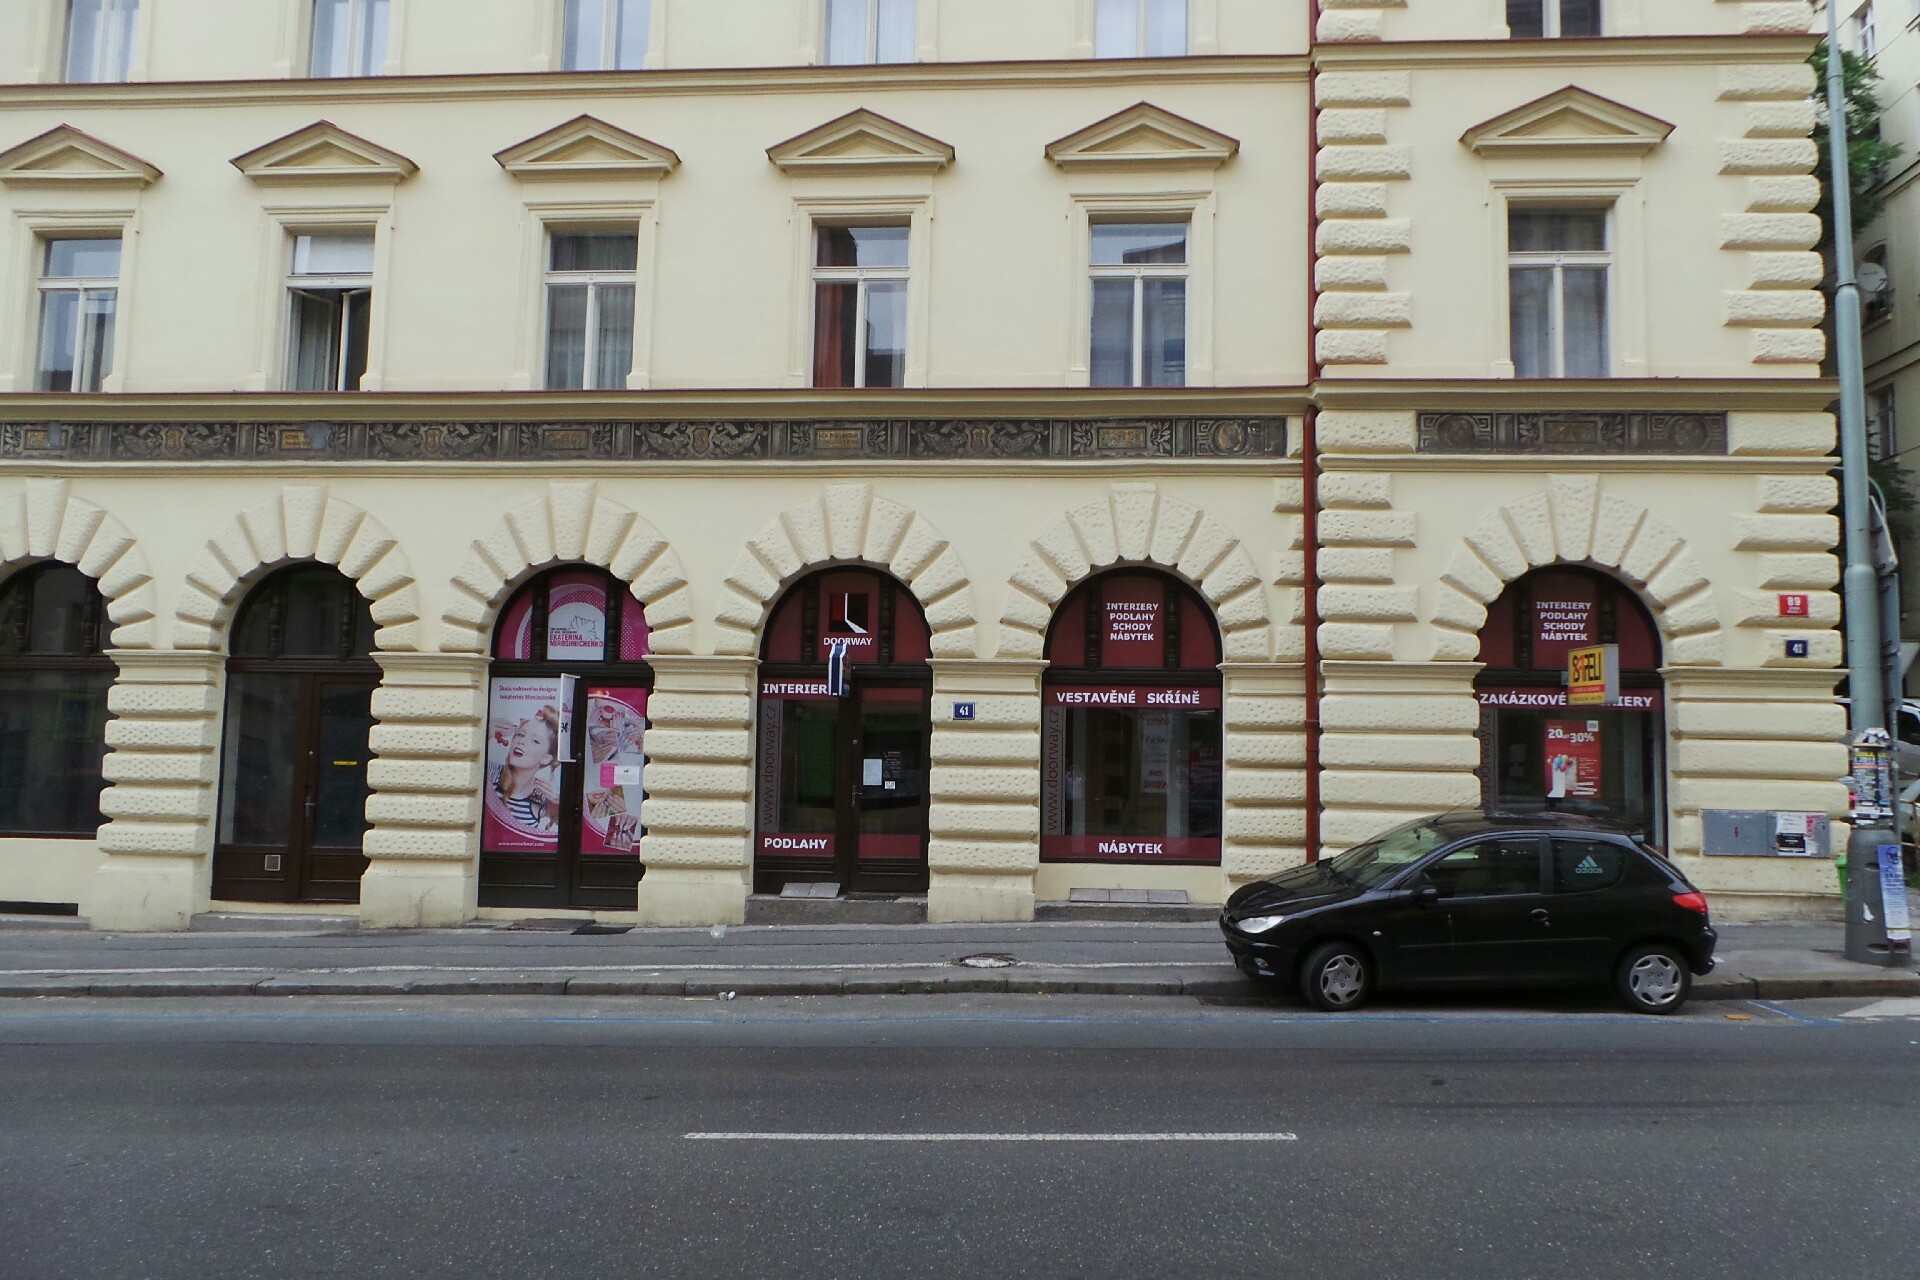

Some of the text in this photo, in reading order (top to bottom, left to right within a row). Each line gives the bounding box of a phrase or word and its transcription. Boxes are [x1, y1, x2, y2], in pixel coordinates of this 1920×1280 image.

[1106, 602, 1159, 611] INTERIERY
[1536, 601, 1591, 610] INTERIERY
[1110, 612, 1155, 621] PODLAHY
[1540, 611, 1588, 620] PODLAHY
[1112, 622, 1152, 631] SCHODY
[1543, 622, 1585, 631] SCHODY
[1110, 630, 1155, 641] NÁBYTEK
[1541, 630, 1588, 641] NÁBYTEK
[823, 637, 873, 646] DOORWAY
[1792, 643, 1803, 653] 41
[1056, 690, 1200, 705] VESTAVĚNÉ SKŘÍNĚ
[1479, 691, 1567, 706] ZAKÁZKOVÉ
[959, 705, 969, 716] 41
[1547, 728, 1563, 739] 20
[1570, 732, 1595, 743] 30%
[762, 705, 778, 826] www.doorway.cz
[1045, 709, 1062, 831] www.doorway.cz
[764, 837, 828, 849] PODLAHY
[1099, 839, 1163, 854] NÁBYTEK
